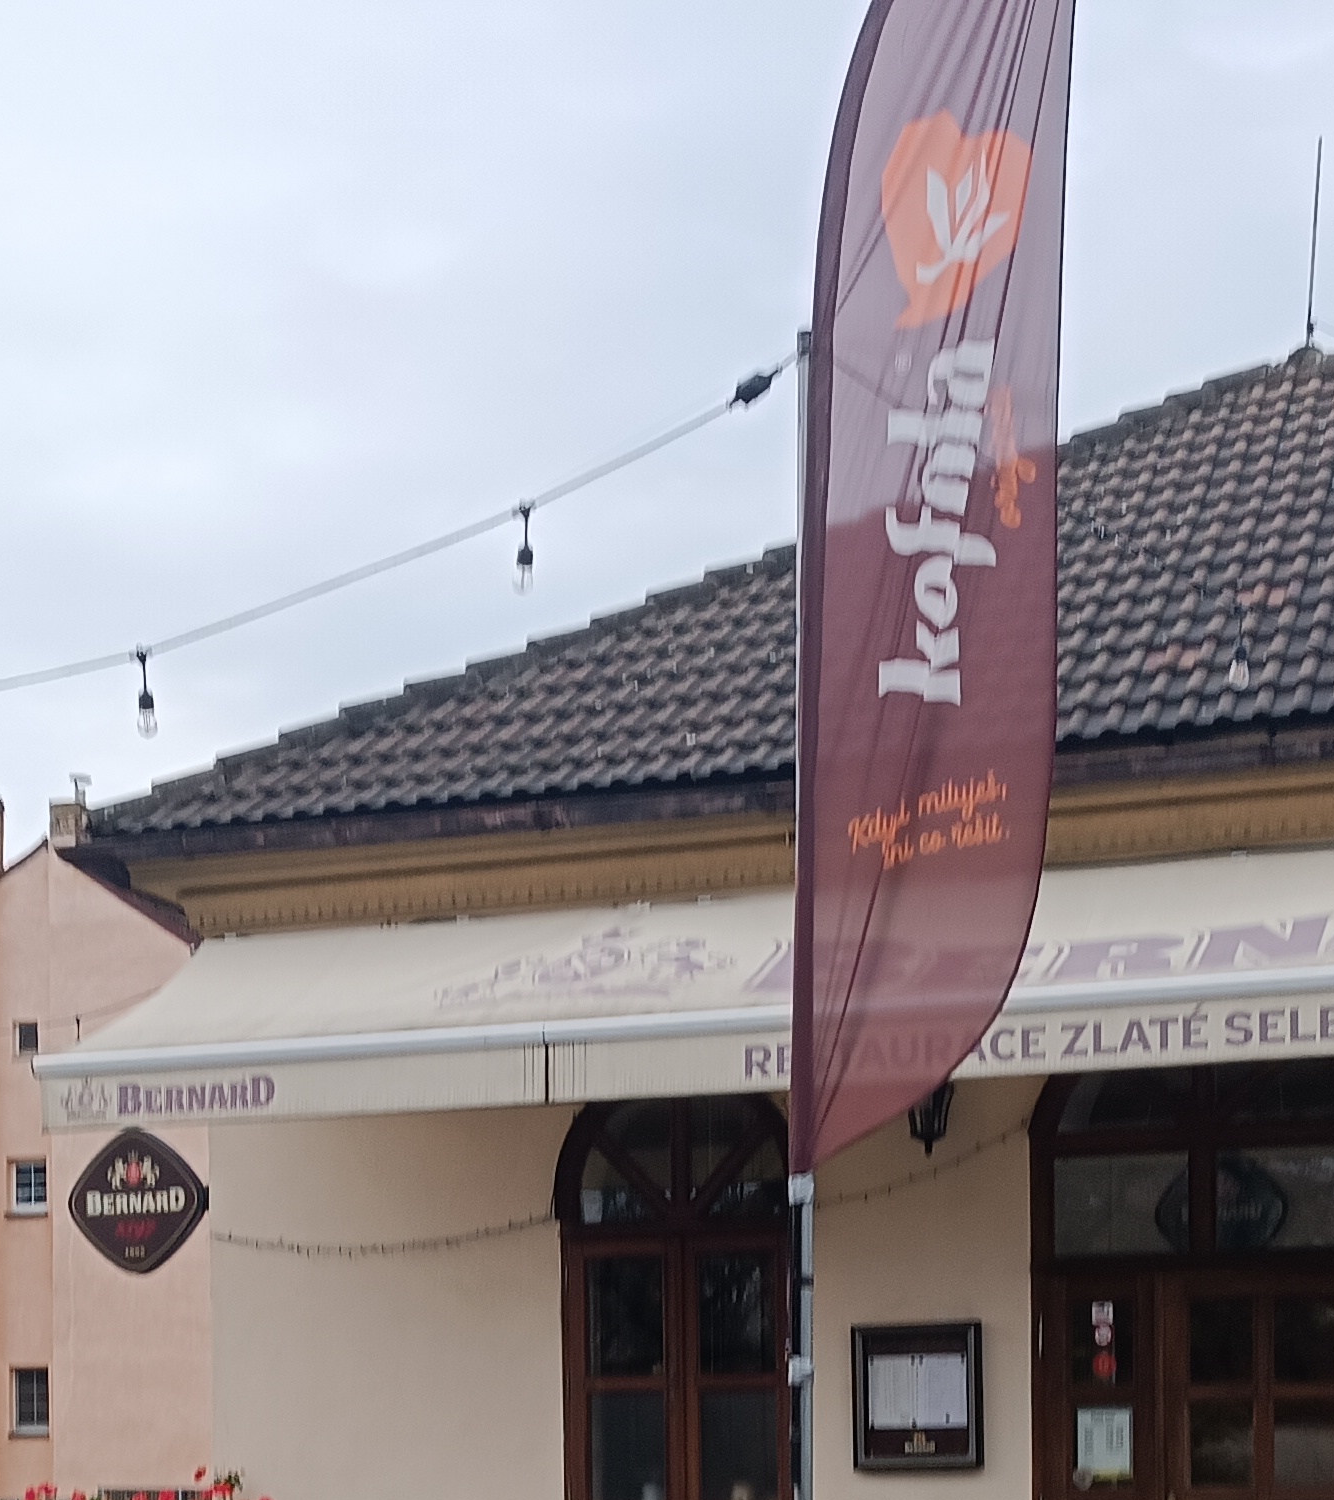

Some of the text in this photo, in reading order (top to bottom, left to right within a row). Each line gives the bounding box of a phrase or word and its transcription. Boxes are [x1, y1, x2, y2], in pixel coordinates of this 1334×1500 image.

[878, 338, 997, 706] kofola
[744, 1023, 1046, 1081] REAURACE
[1060, 1000, 1208, 1058] ZLATÉ
[118, 1074, 276, 1115] BERNARD
[86, 1186, 186, 1218] BERNARD
